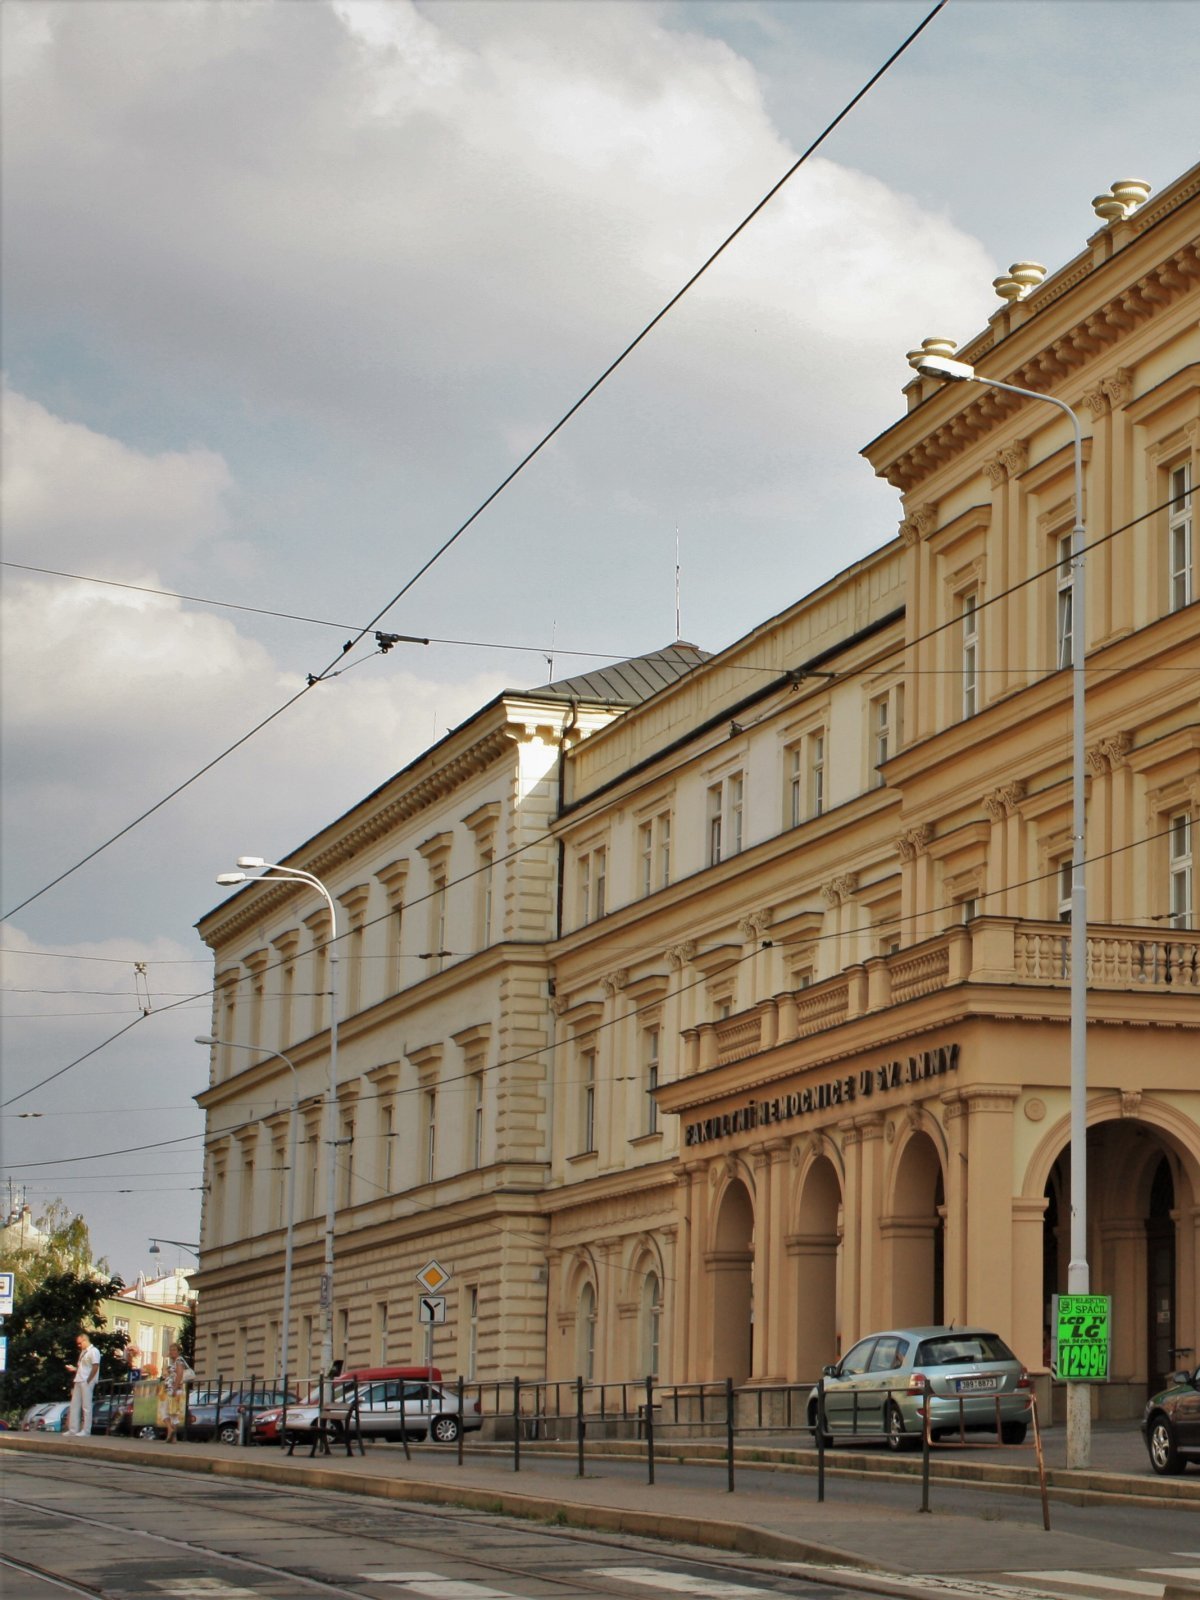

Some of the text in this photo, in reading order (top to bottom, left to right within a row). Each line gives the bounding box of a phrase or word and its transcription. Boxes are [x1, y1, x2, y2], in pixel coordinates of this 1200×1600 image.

[756, 1074, 855, 1126] NEMOCNICE
[860, 1069, 873, 1096] U
[904, 1043, 960, 1083] ANNY
[1060, 1316, 1107, 1325] LCD TV
[1071, 1324, 1100, 1338] LG
